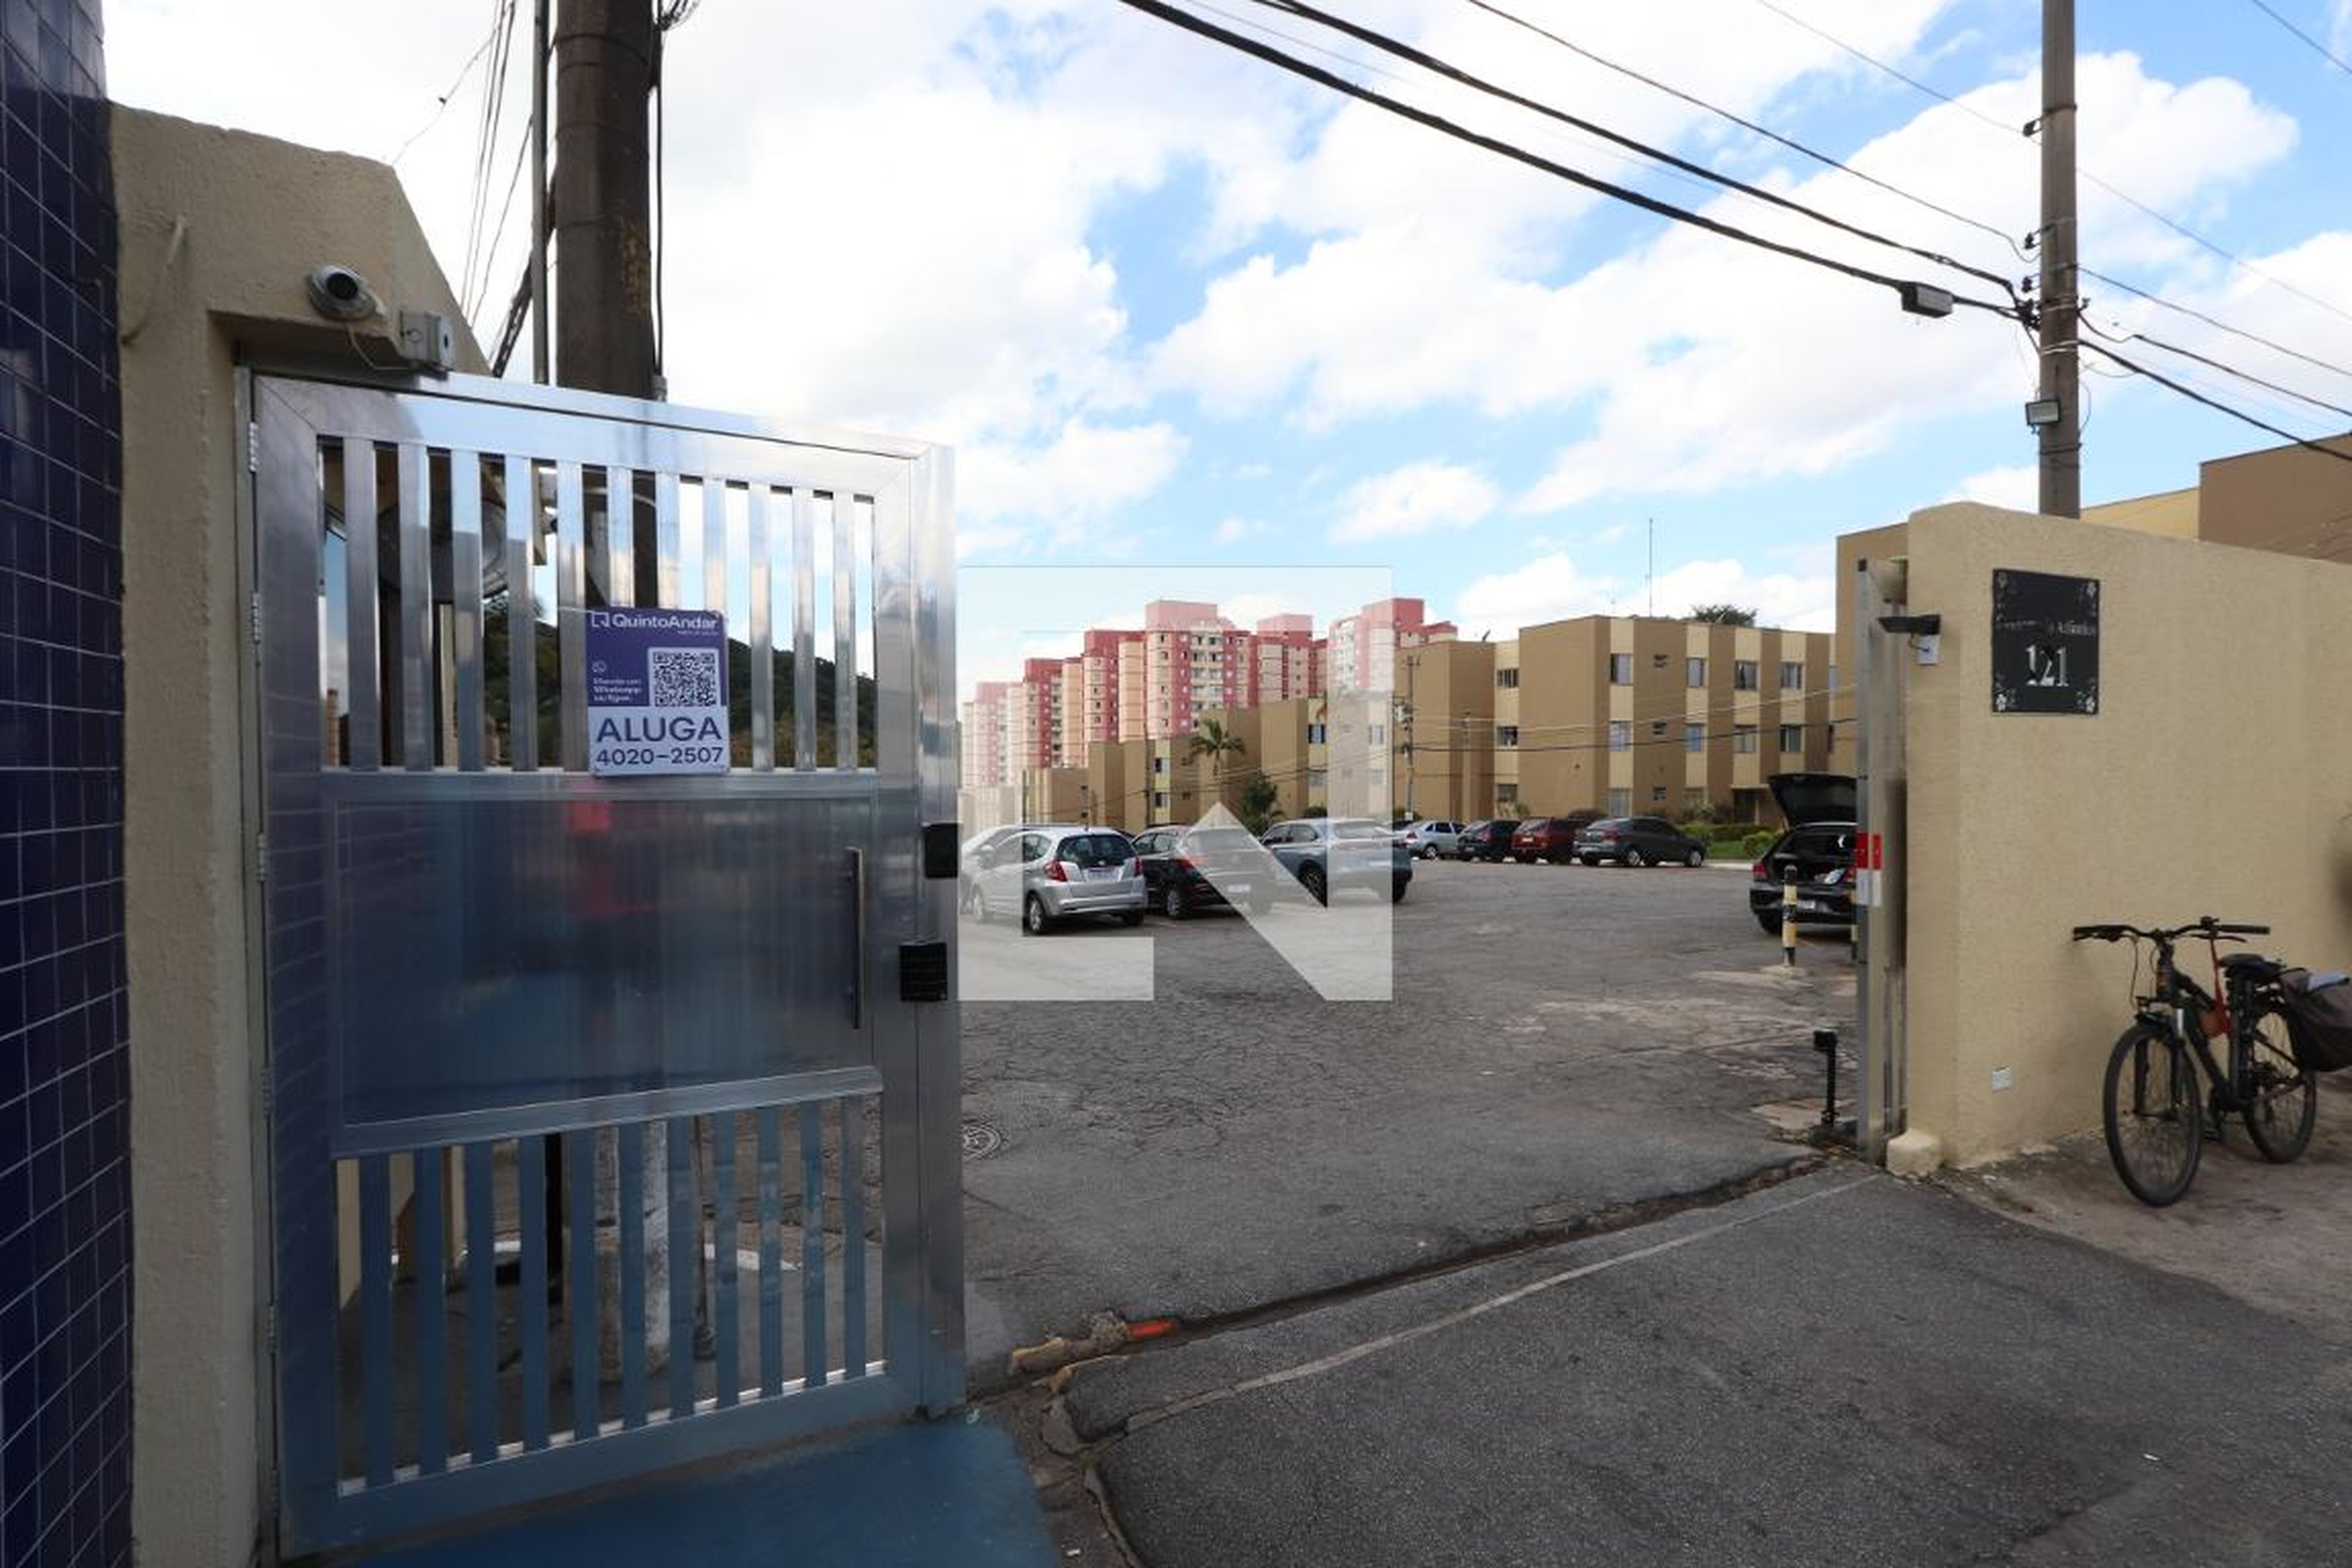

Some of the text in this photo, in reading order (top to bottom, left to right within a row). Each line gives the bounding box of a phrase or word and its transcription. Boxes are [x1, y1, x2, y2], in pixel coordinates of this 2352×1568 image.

[612, 614, 719, 628] QuintoAndar
[597, 717, 722, 742] ALUGA
[595, 747, 724, 766] 4020-2507
